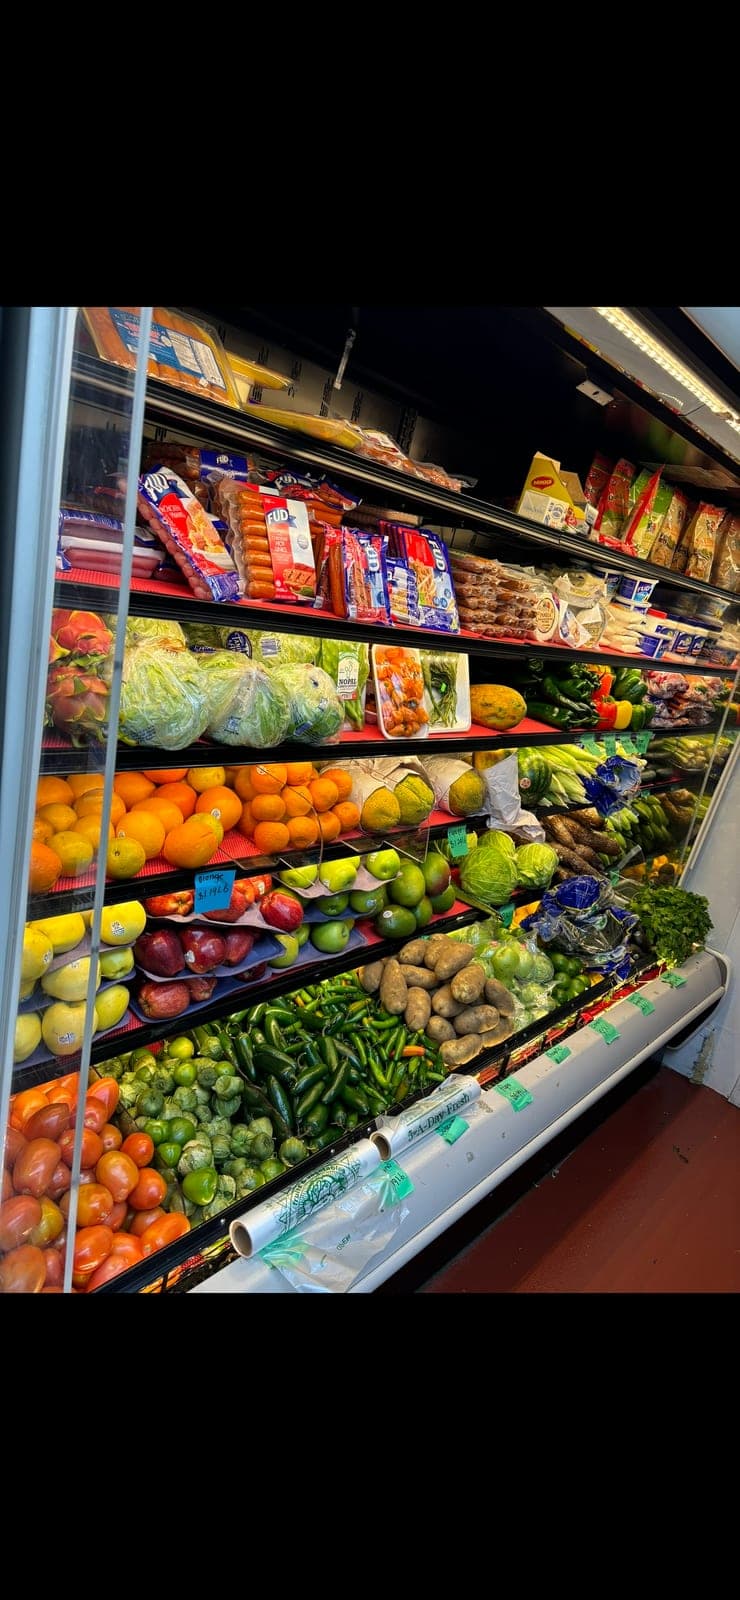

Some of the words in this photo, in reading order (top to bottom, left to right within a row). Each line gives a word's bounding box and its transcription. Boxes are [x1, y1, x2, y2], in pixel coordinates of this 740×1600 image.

[216, 455, 229, 464] FUD
[144, 473, 170, 502] FUD
[267, 508, 289, 524] FUD
[428, 540, 446, 571] FUD
